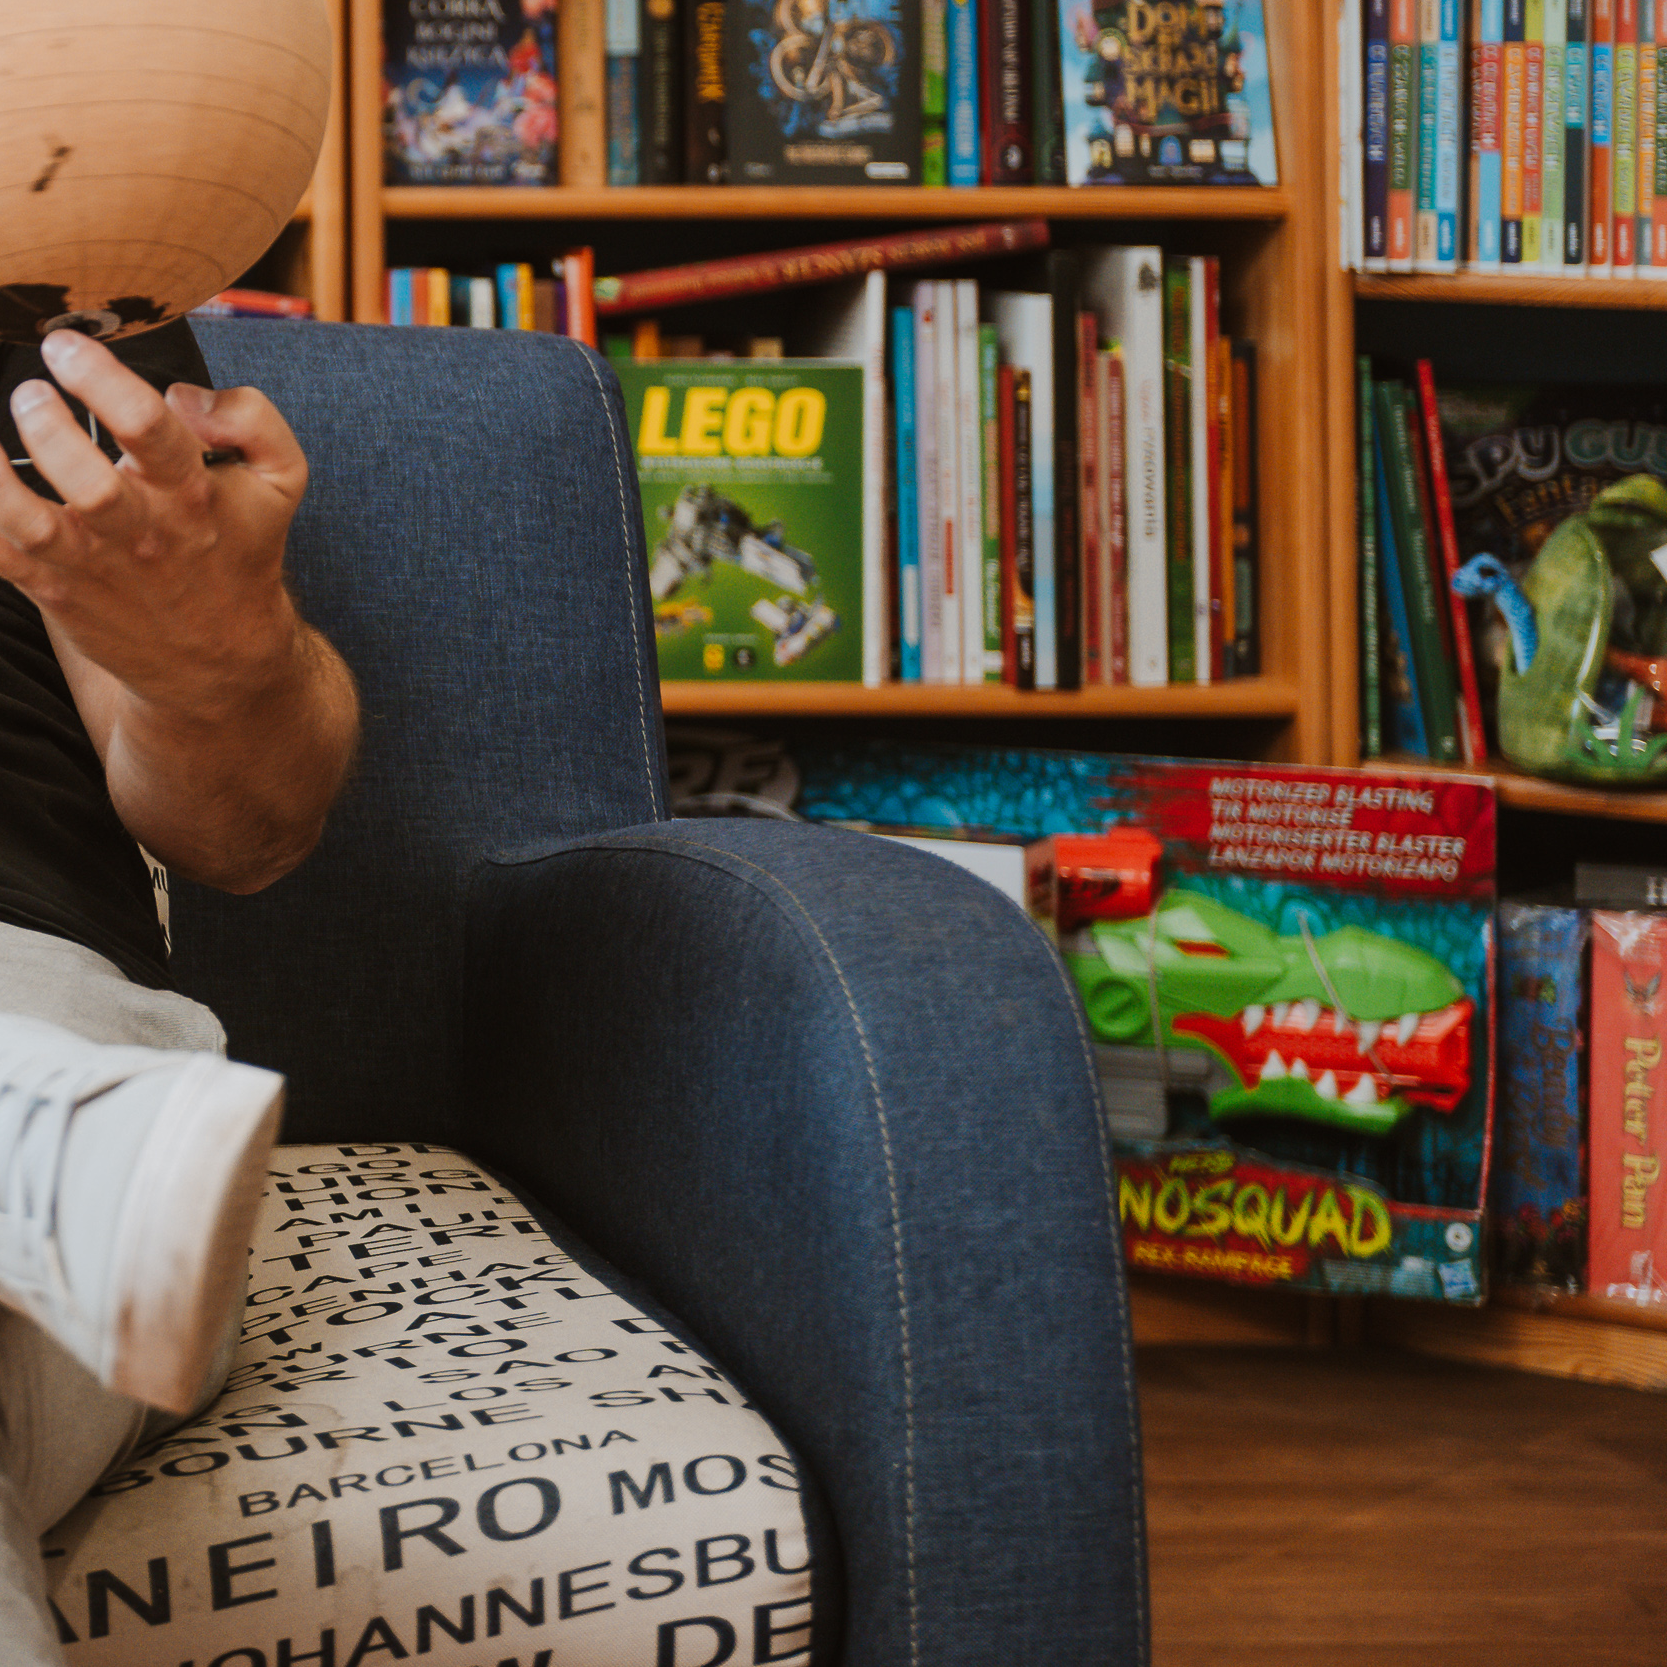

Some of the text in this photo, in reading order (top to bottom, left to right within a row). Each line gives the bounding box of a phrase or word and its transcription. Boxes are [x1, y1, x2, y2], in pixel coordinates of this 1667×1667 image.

[637, 385, 827, 457] LEGO
[1209, 776, 1435, 815] MOTORIZED BLASTING
[1378, 829, 1467, 861] BLASTER
[1620, 1034, 1662, 1230] Peter Pan
[1118, 1175, 1392, 1259] NOSQUAD
[237, 1428, 639, 1519] BARCELONA
